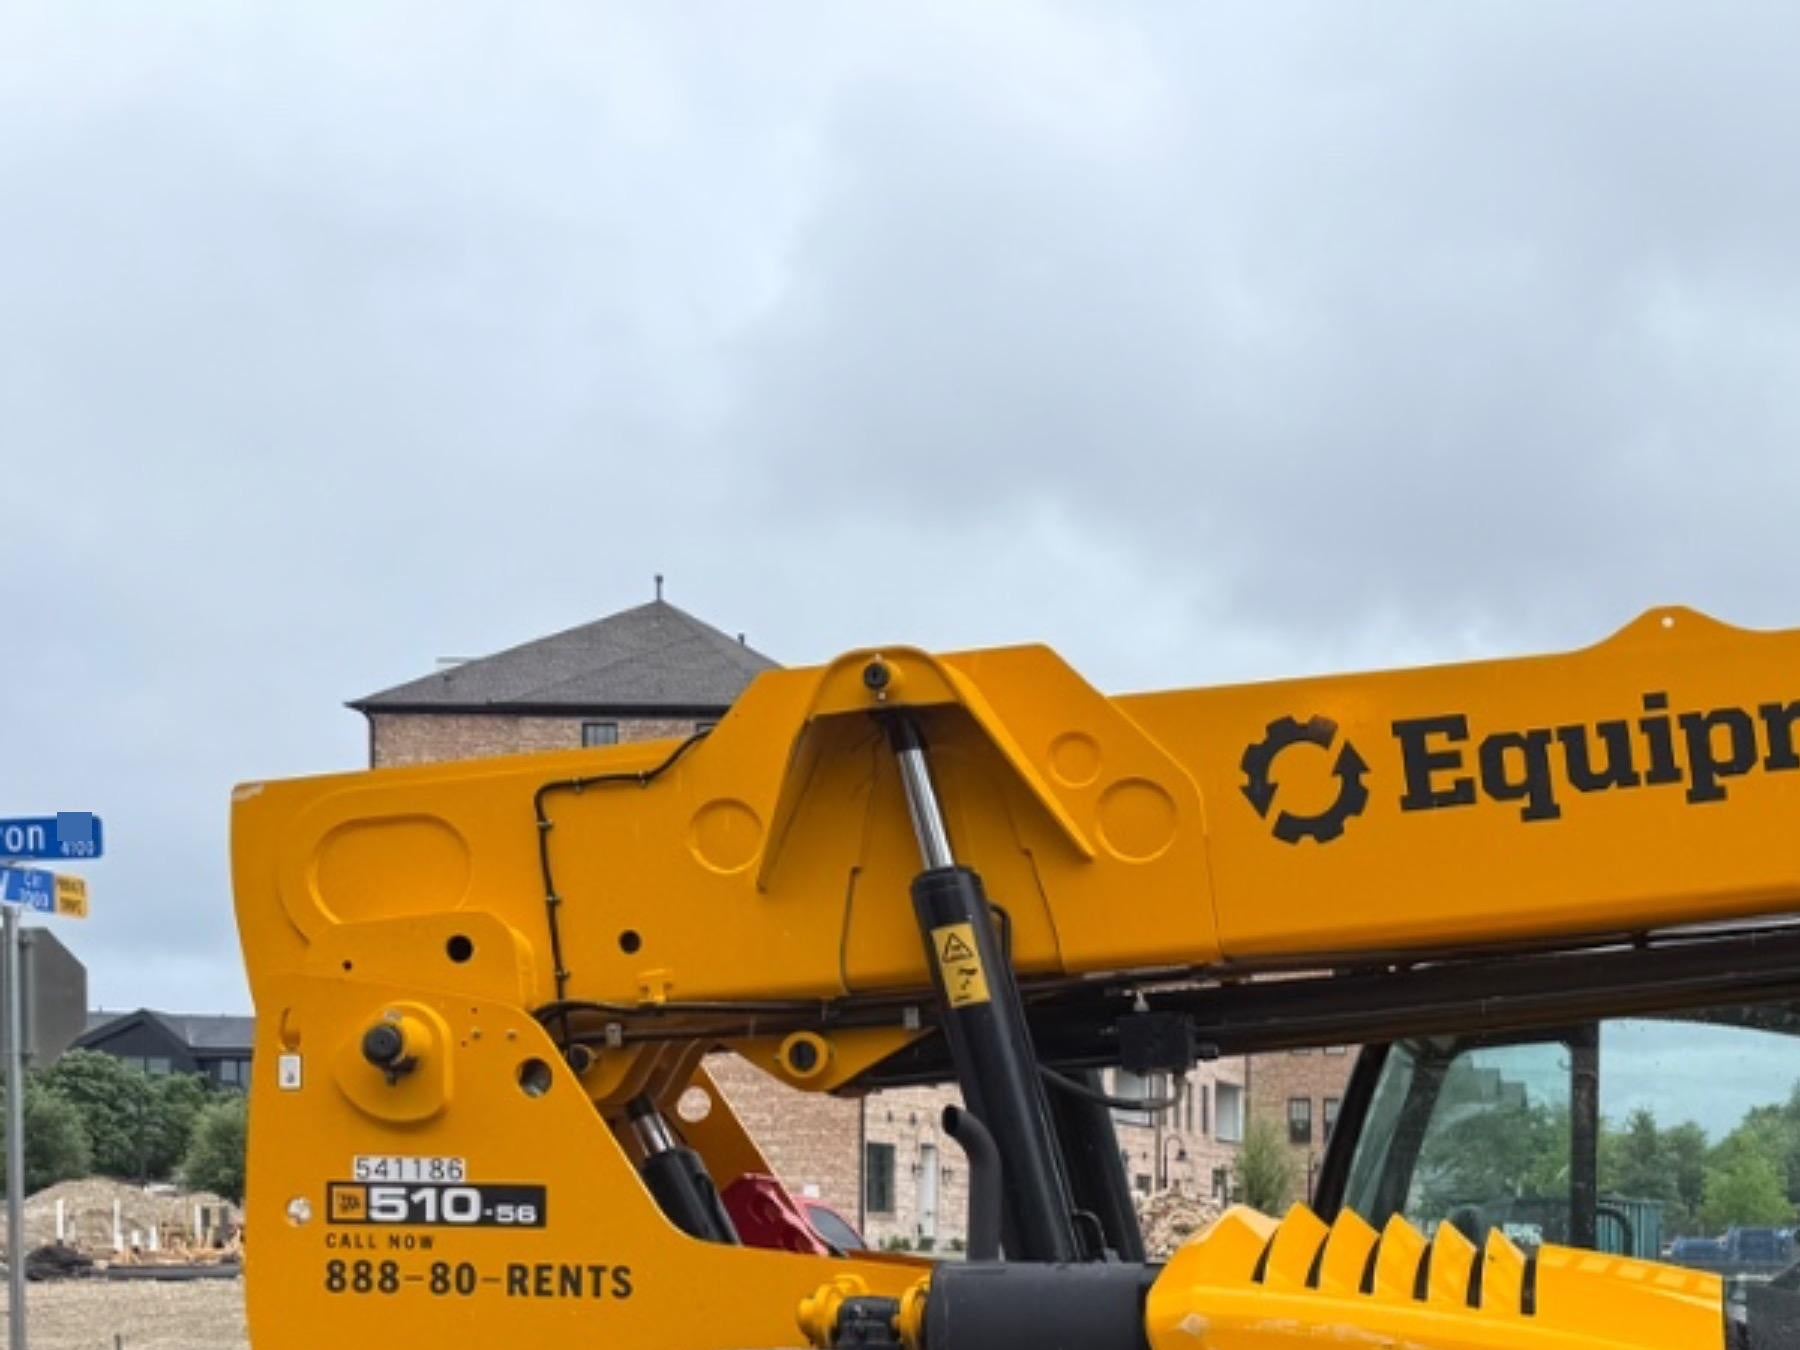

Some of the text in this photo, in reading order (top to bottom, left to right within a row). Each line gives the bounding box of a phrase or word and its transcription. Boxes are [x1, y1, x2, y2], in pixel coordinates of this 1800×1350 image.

[0, 824, 46, 853] on
[356, 1158, 464, 1180] 541186
[326, 1233, 435, 1249] CALL NOW
[325, 1259, 633, 1299] 888-80-RENTS
